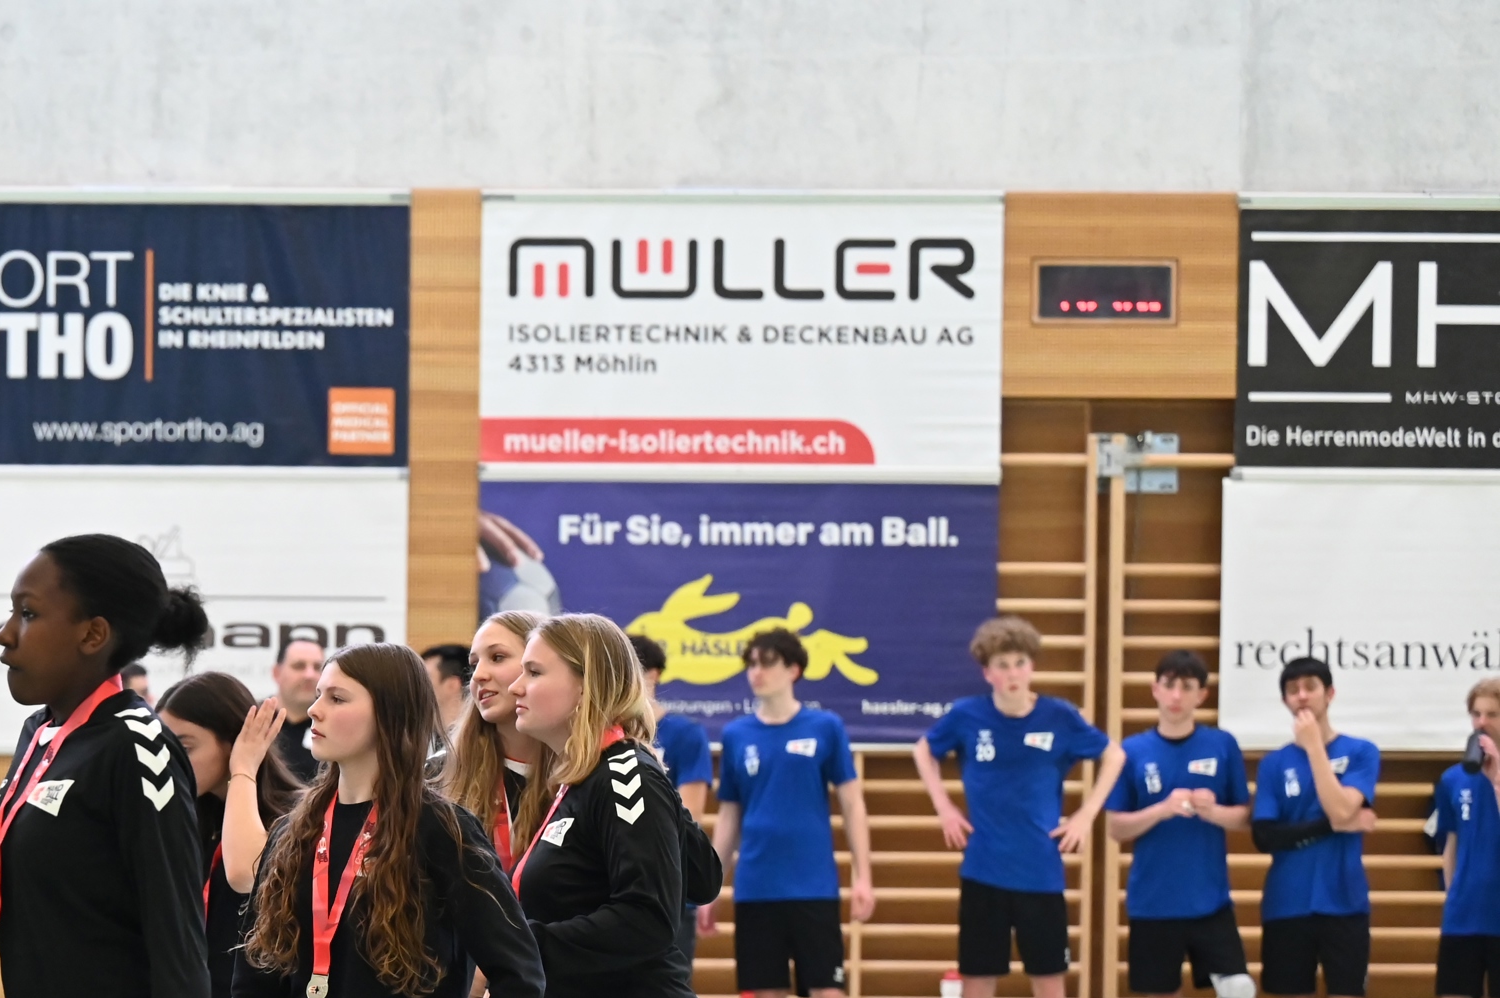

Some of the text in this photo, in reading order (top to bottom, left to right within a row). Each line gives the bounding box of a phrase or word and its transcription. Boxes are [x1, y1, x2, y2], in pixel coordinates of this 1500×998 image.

[158, 283, 270, 303] DIE KNIE &
[158, 307, 395, 328] SCHULTERSPEZIALISTEN
[158, 330, 325, 350] IN RHEINFELDEN
[508, 324, 975, 346] ISOLIERTECHNIK & DECKENBAU AG
[508, 353, 658, 374] 4313 Möhlin
[33, 417, 265, 448] www.sportortho.ag
[503, 429, 847, 456] mueller-isoliertechnik.ch
[1245, 425, 1487, 449] Die HerrenmodeWelt in
[558, 514, 959, 549] Für Sie, immer am Ball.
[975, 742, 996, 762] 20
